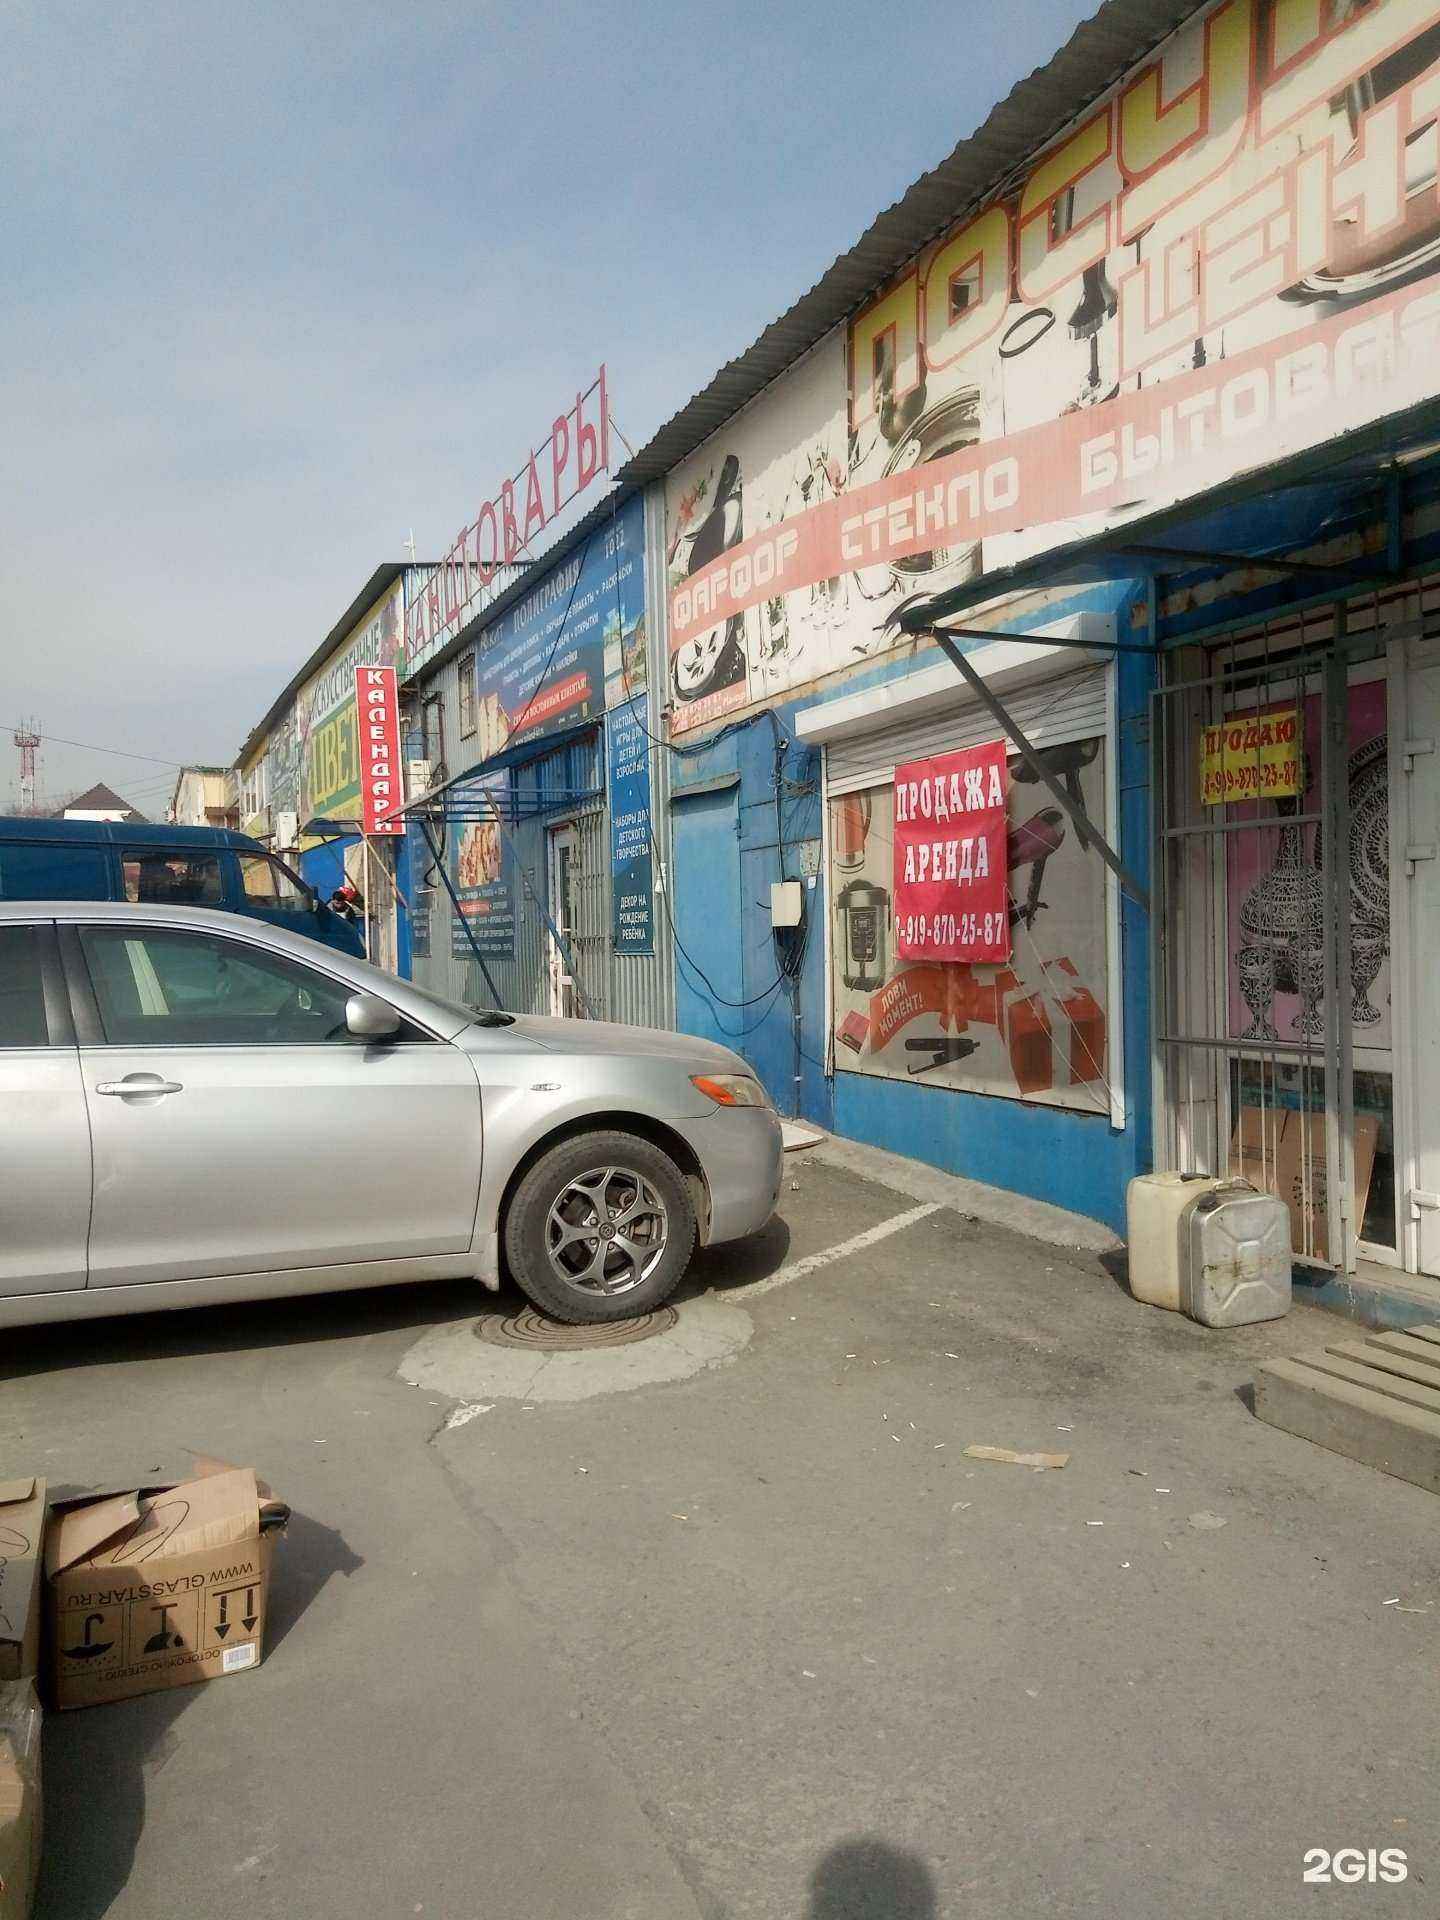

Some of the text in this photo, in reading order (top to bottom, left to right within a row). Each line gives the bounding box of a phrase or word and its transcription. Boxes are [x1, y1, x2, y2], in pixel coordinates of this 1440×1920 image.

[673, 527, 800, 631] ФАРФОР
[840, 456, 1020, 561] СТЕКЛО
[1205, 719, 1296, 754] ПРОДАЮ
[310, 703, 358, 806] ЦВЕТ
[896, 764, 1004, 824] ПРОДАЖА
[616, 843, 649, 861] ТВОРЧЕСТВА
[618, 827, 646, 845] ДЕТСКОГО
[904, 836, 989, 887] АРЕНДА
[619, 910, 649, 926] РОЖДЕНИЕ
[620, 894, 647, 910] ДЕКОР НА
[881, 979, 908, 1013] ЛОВИ
[879, 992, 924, 1037] МОМЕНТ!
